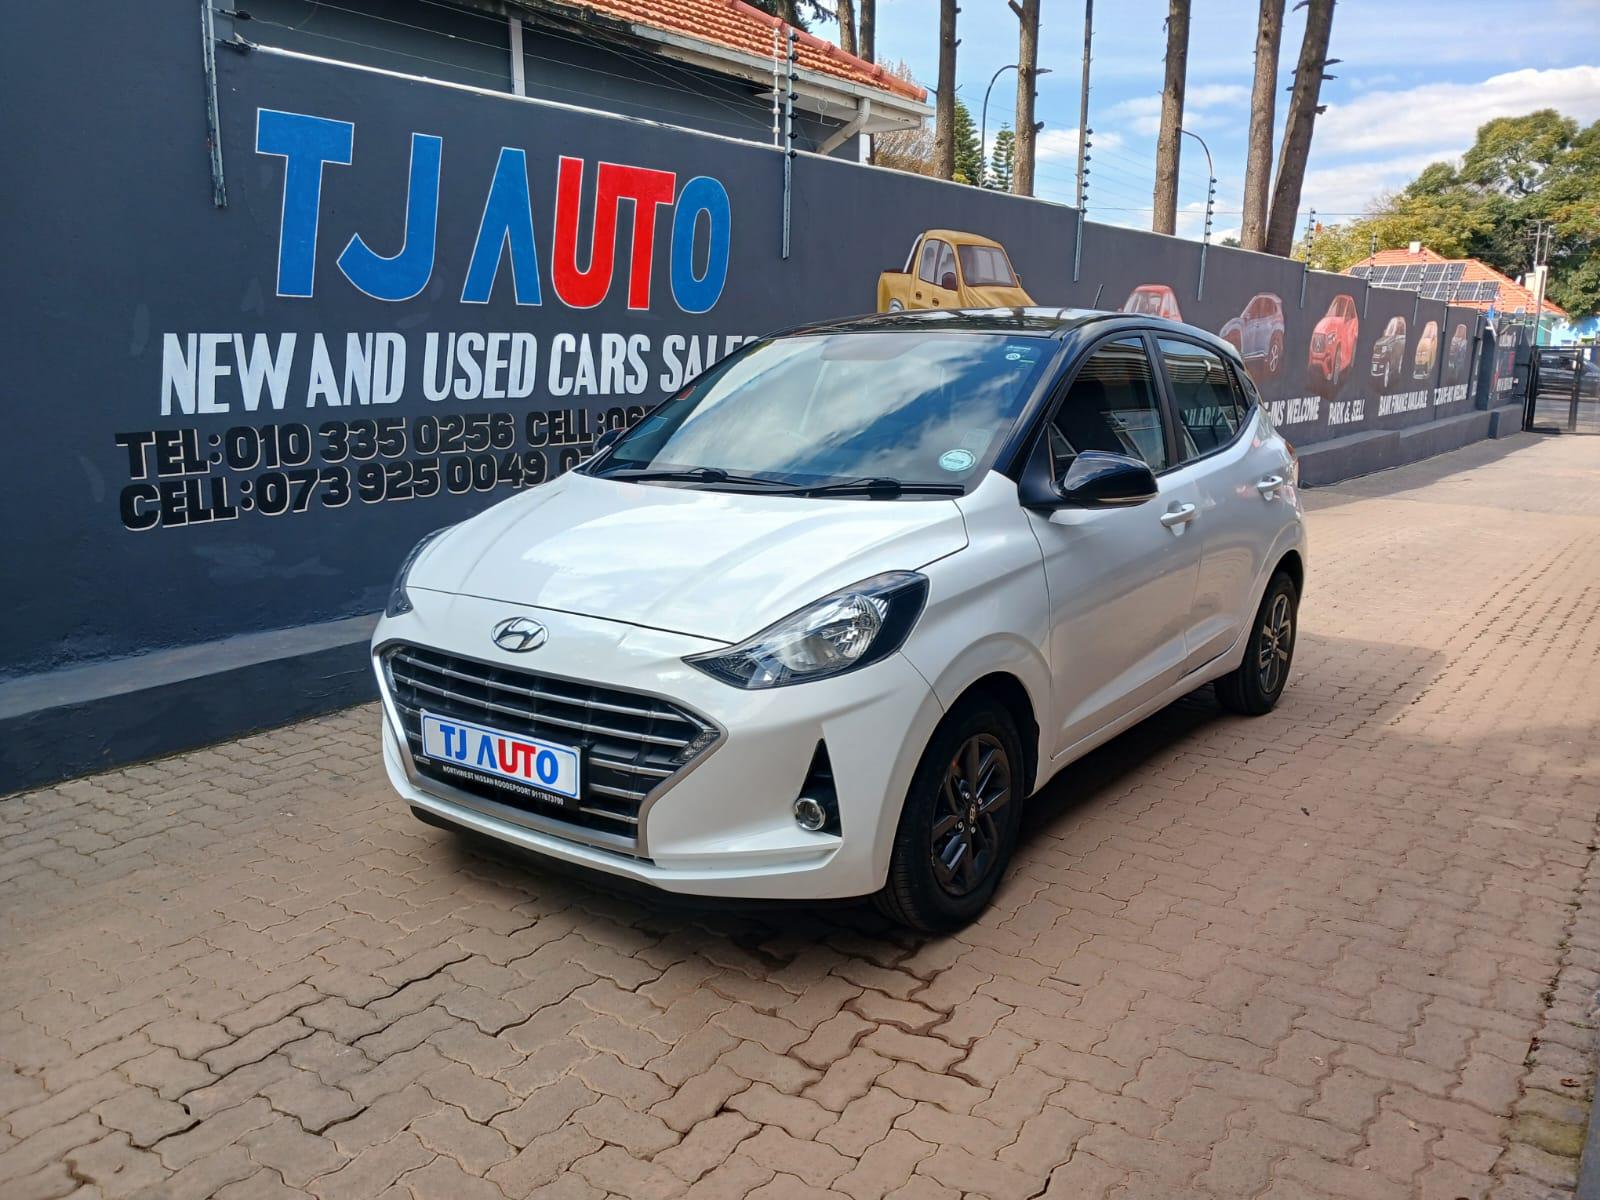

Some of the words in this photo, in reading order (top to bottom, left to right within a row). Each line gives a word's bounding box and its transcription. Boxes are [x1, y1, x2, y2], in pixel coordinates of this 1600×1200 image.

[255, 107, 443, 301] TJ
[460, 147, 731, 313] AUTO
[160, 332, 297, 416] NEW
[306, 332, 407, 408] AND
[422, 332, 538, 402] USED
[548, 333, 651, 397] CARS
[660, 335, 762, 393] SAL
[1286, 396, 1321, 425] WELCOME
[1327, 401, 1345, 425] PARK
[1344, 401, 1351, 423] &
[1350, 399, 1366, 422] SELL
[114, 423, 312, 480] TEL:010
[318, 416, 408, 463] 335
[413, 412, 515, 454] 0256
[119, 465, 352, 531] CELL:073
[357, 456, 441, 505] 925
[446, 450, 548, 495] 0049
[440, 723, 467, 761] TJ
[477, 735, 559, 785] AUTO
[474, 773, 494, 786] NISSAN
